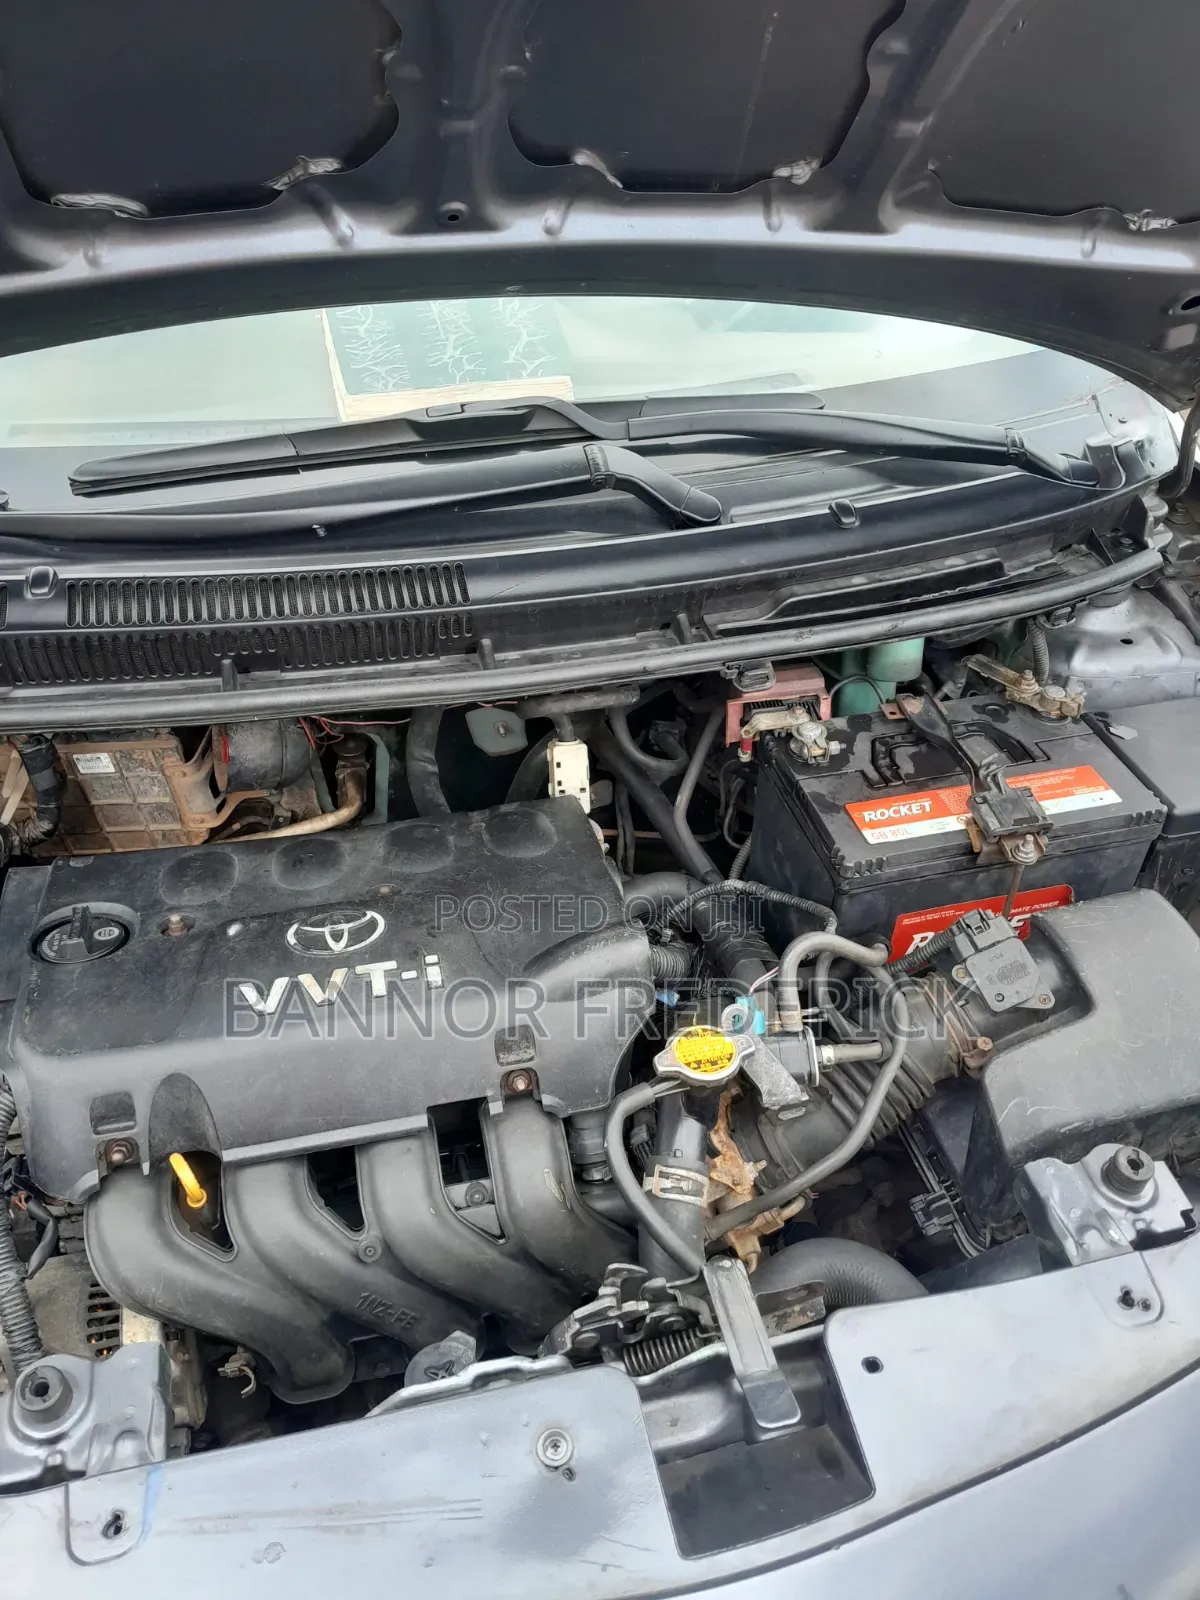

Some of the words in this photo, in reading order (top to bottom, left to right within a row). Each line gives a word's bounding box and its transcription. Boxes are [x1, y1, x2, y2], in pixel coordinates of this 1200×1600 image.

[861, 801, 932, 822] ROCKET
[1031, 900, 1060, 910] POWER
[238, 953, 445, 1016] VVT-i
